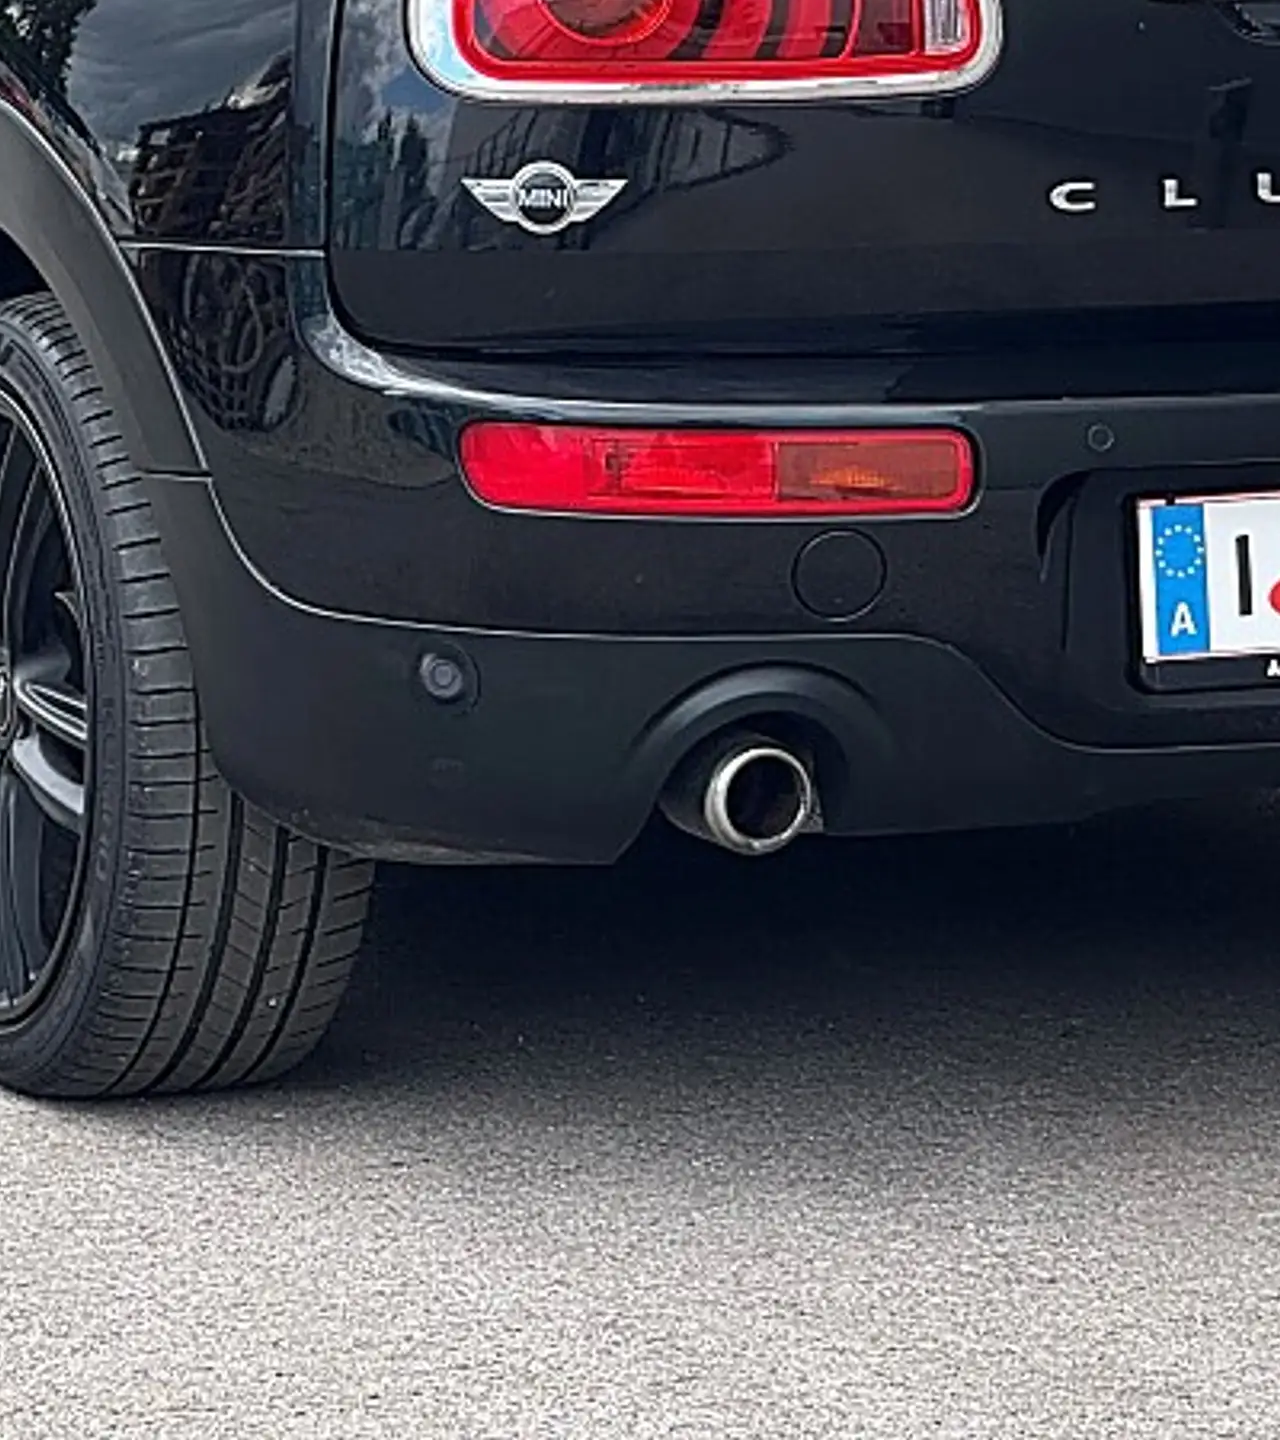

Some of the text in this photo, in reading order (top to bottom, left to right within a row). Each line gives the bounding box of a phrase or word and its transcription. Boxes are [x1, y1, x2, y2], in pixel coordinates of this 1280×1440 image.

[519, 188, 568, 209] MINI
[1235, 534, 1253, 615] I
[1170, 603, 1196, 638] A
